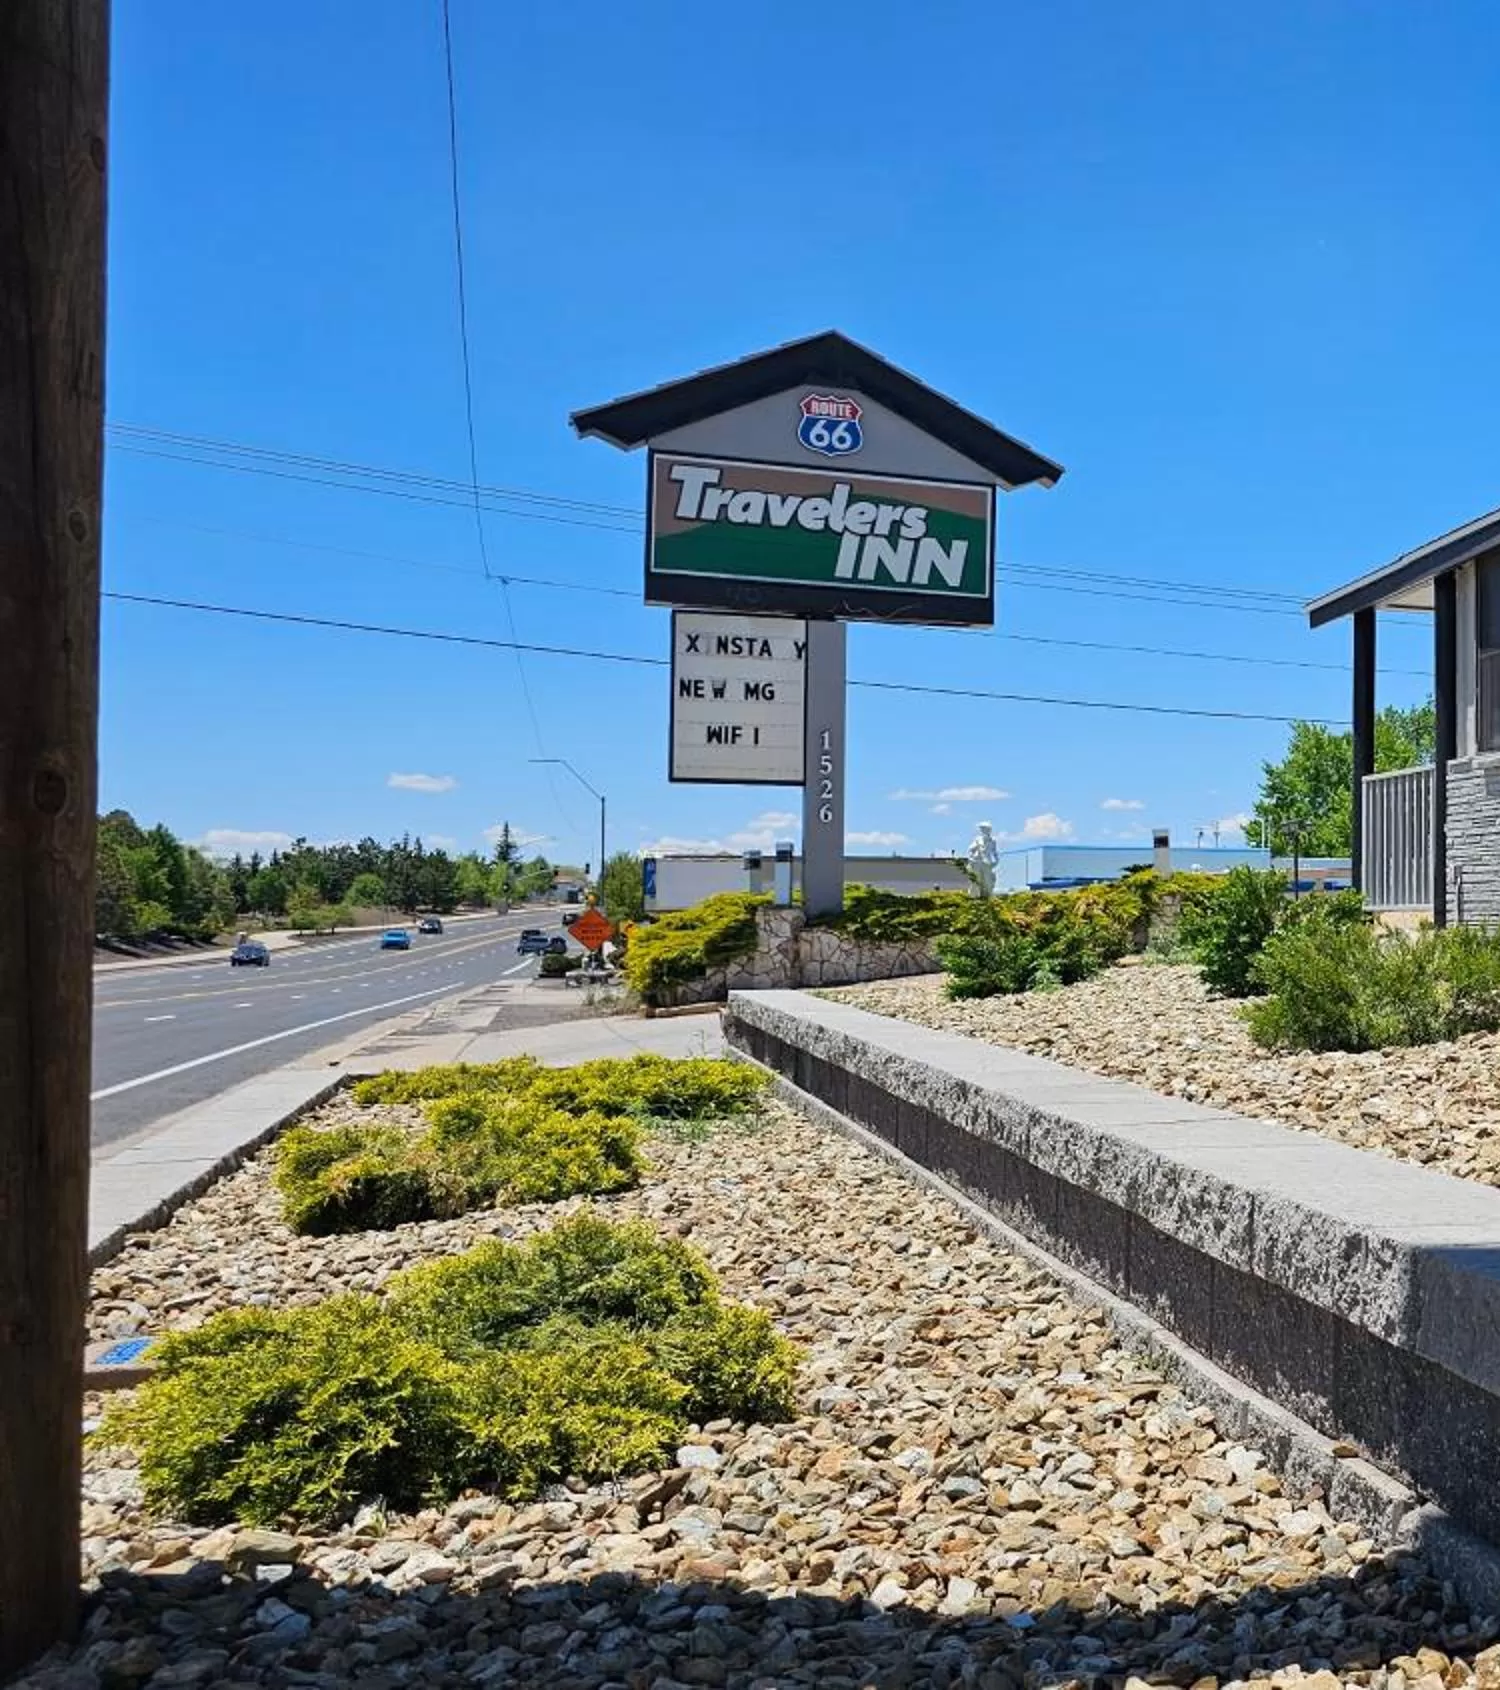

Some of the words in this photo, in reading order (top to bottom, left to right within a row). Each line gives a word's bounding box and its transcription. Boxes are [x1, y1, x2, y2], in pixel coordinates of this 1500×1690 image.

[810, 400, 854, 417] ROUTE
[809, 419, 853, 448] 66
[669, 464, 928, 539] Travelers
[834, 533, 969, 588] INN
[744, 682, 775, 701] MG
[819, 732, 833, 823] 1526
